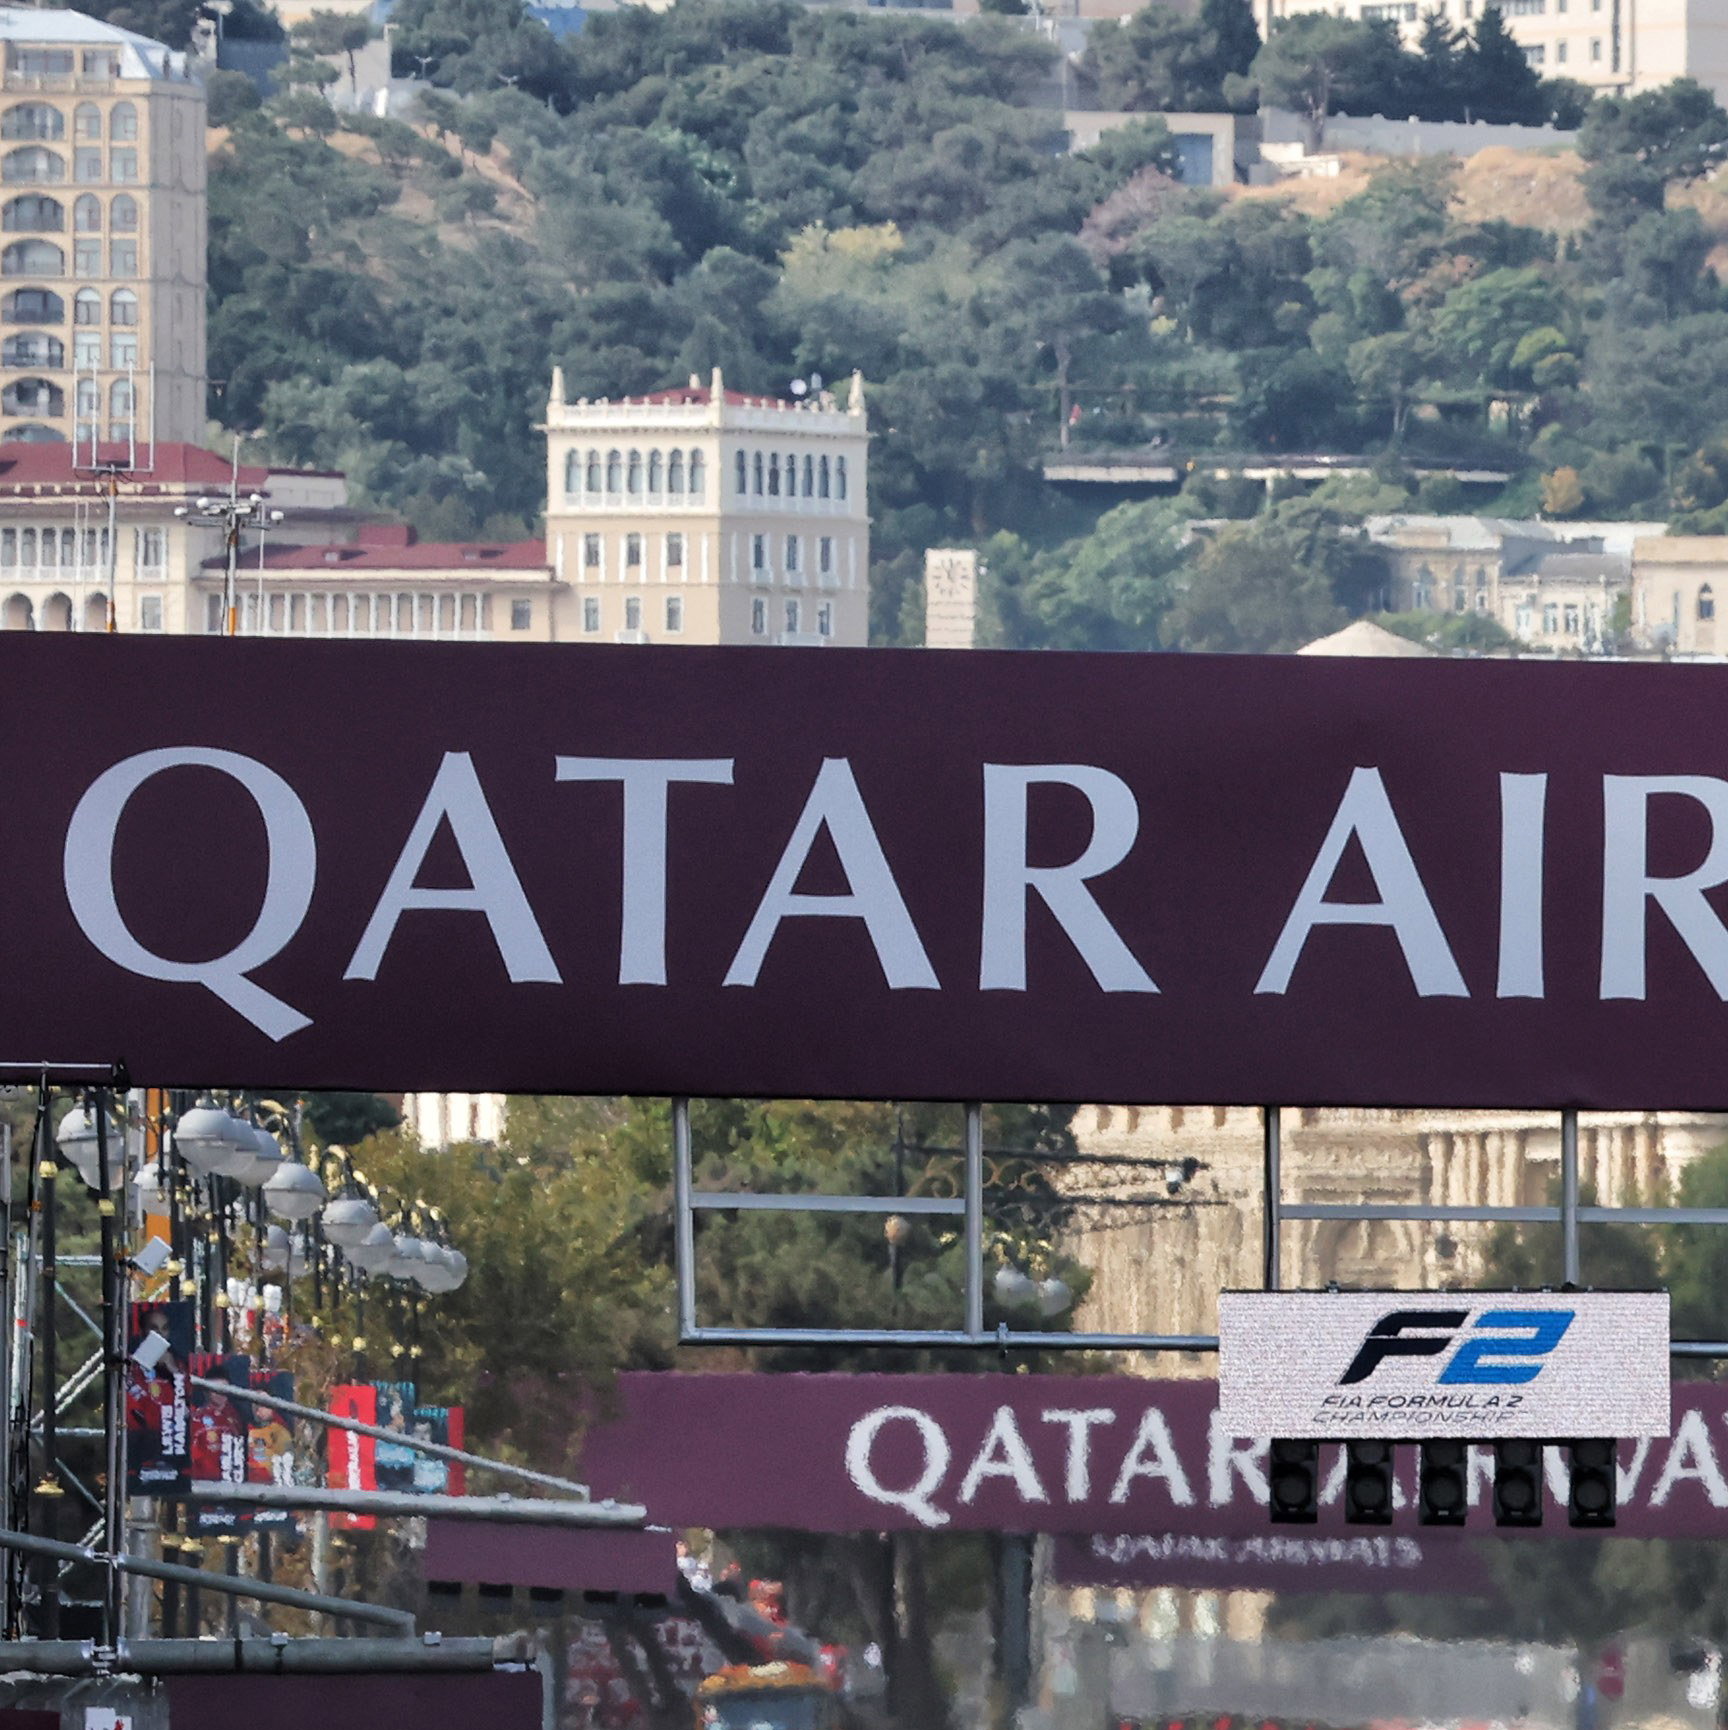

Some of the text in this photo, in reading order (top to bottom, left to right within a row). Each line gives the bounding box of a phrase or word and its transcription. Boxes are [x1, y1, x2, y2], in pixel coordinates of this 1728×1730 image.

[62, 744, 1162, 1043] QATAR
[1335, 1309, 1577, 1386] F2
[1311, 1411, 1519, 1425] CHAMPIONSHIP
[1321, 1394, 1524, 1409] FIA FORMULA 2
[845, 1405, 1272, 1528] QATAR
